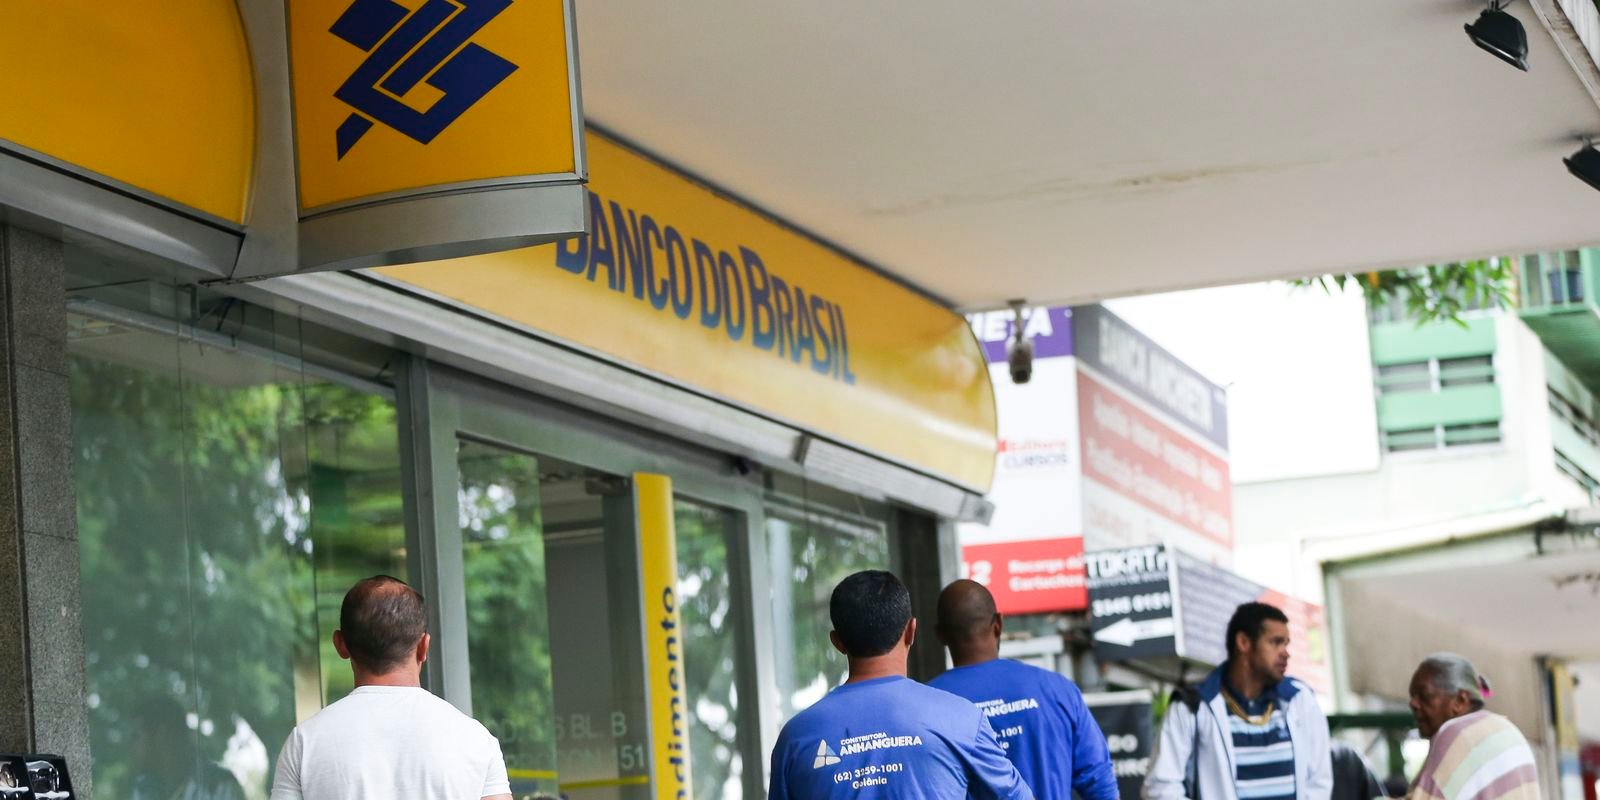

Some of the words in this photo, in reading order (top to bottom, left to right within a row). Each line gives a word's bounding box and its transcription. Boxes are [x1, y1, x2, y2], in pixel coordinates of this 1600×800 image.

[691, 237, 746, 342] DO
[738, 245, 856, 386] BRASIL
[840, 732, 887, 745] CONSTRUTORA
[840, 736, 922, 756] ANHANGUERA
[834, 771, 852, 784] (62)
[855, 763, 903, 778] 3259-1001
[852, 776, 887, 790] Goiânia
